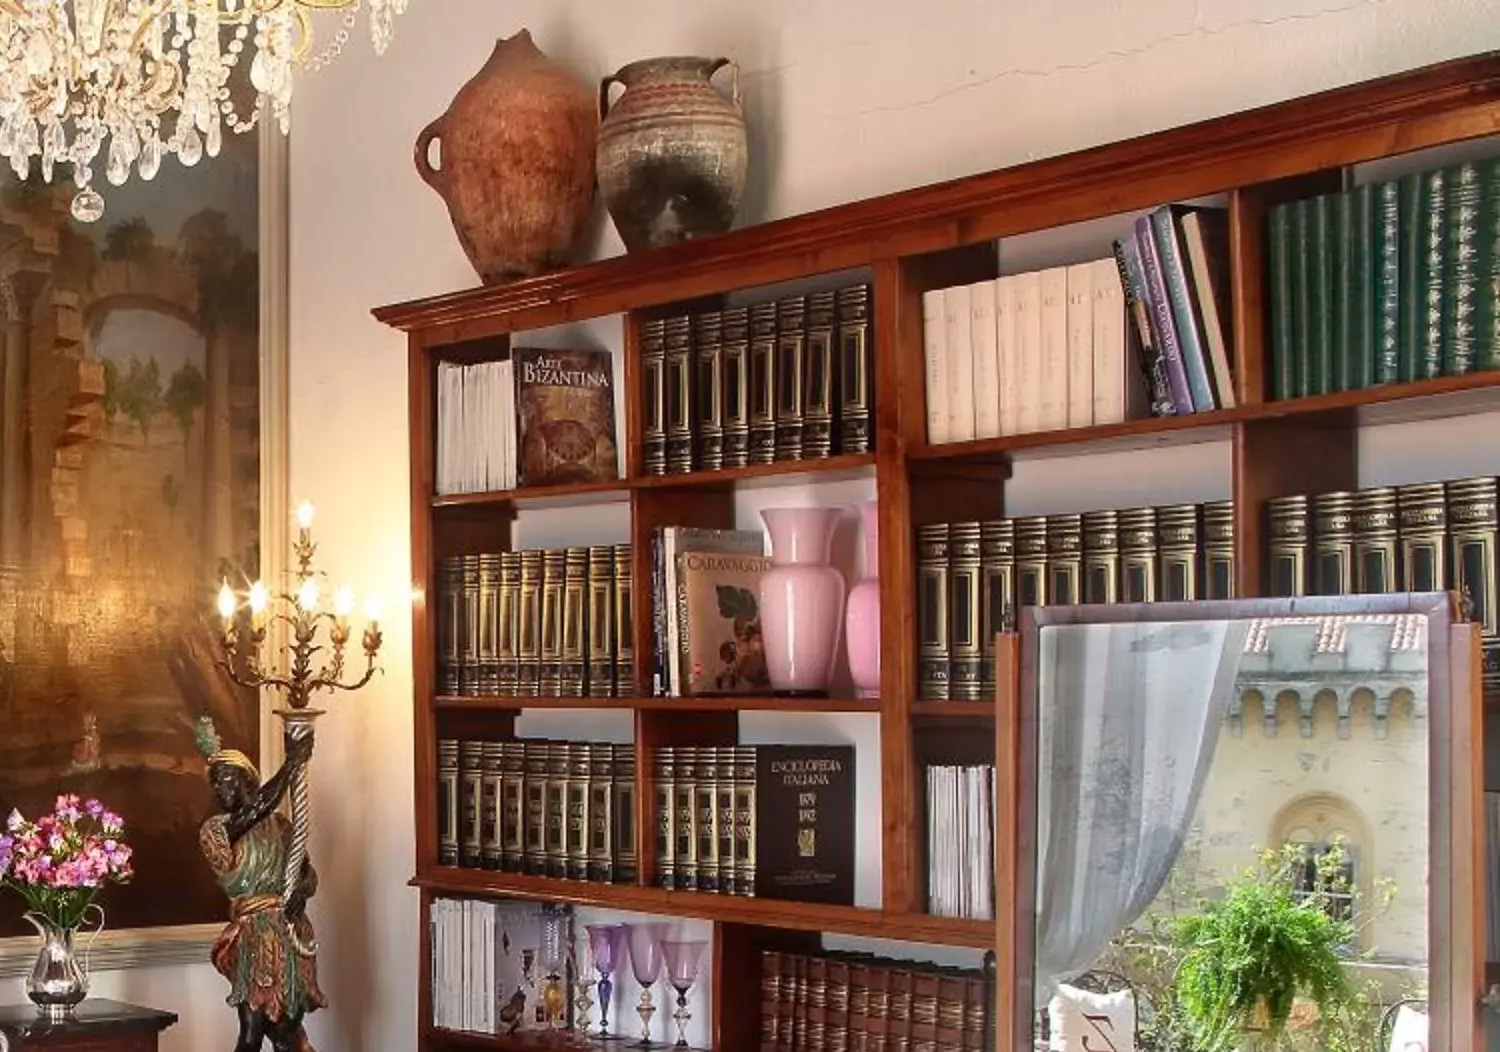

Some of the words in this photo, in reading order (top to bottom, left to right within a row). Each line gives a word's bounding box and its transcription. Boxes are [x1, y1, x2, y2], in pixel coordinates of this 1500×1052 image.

[522, 361, 609, 388] BIZANTINA
[771, 759, 842, 773] ENCICLOPEDIA
[783, 773, 830, 785] ITALIANA
